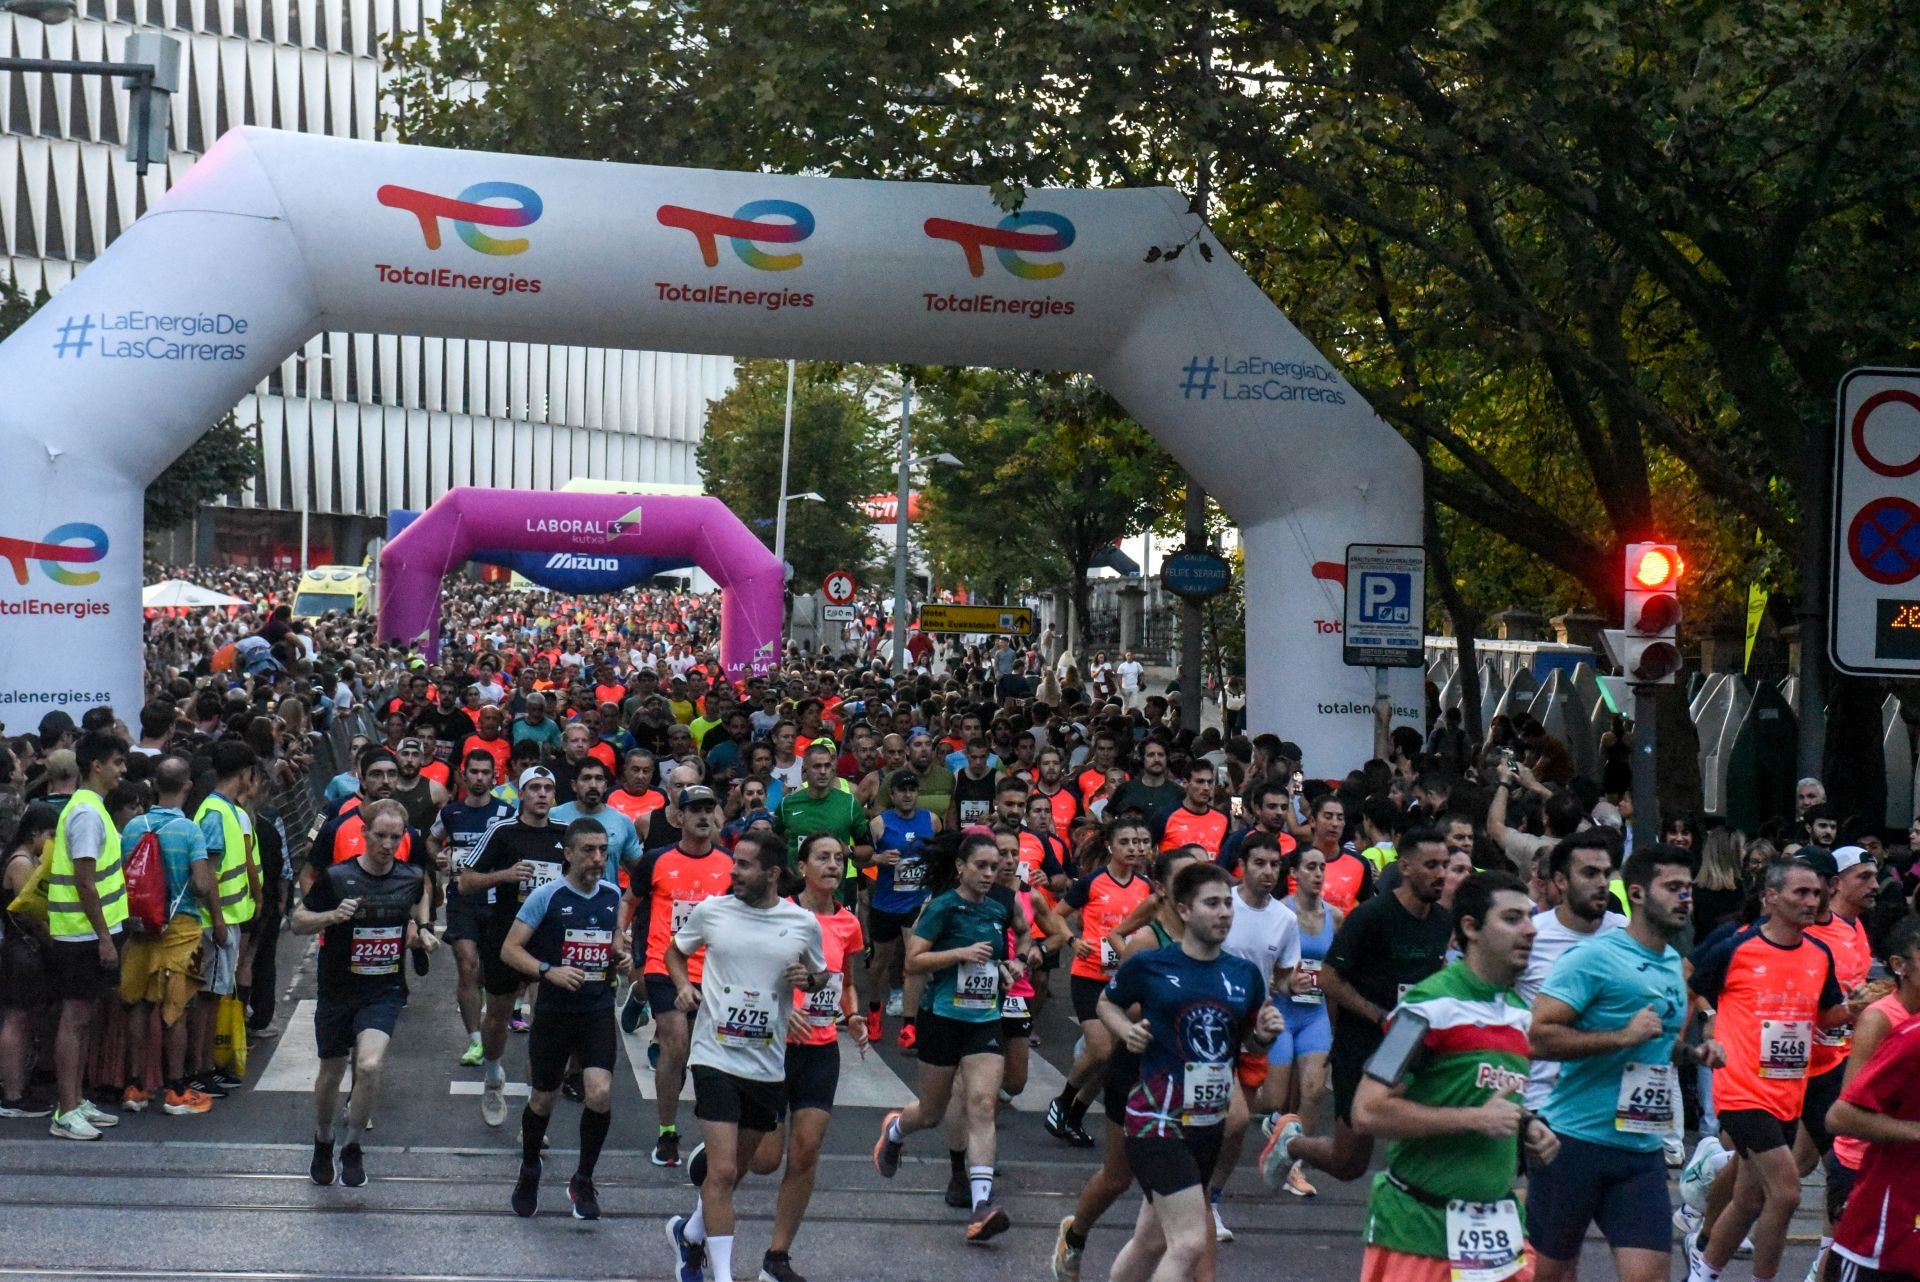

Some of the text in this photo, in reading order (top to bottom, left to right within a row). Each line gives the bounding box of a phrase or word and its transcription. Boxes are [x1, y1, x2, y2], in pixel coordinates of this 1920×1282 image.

[375, 264, 542, 295] TotalEnergies
[655, 282, 815, 310] TotalEnergies
[922, 293, 1076, 319] TotalEnergies
[100, 337, 247, 361] LasCarreras
[1223, 380, 1346, 405] LasCarreras
[526, 519, 605, 533] LABORAL
[571, 535, 605, 544] kutxa
[0, 599, 110, 618] talEnergies
[922, 608, 946, 617] Hotel
[355, 943, 398, 956] 22493
[566, 946, 608, 961] 21836
[965, 976, 994, 989] 4938
[811, 990, 836, 1004] 4932
[728, 1006, 769, 1025] 7675
[1770, 1040, 1805, 1055] 5468
[1457, 1229, 1510, 1250] 4958
